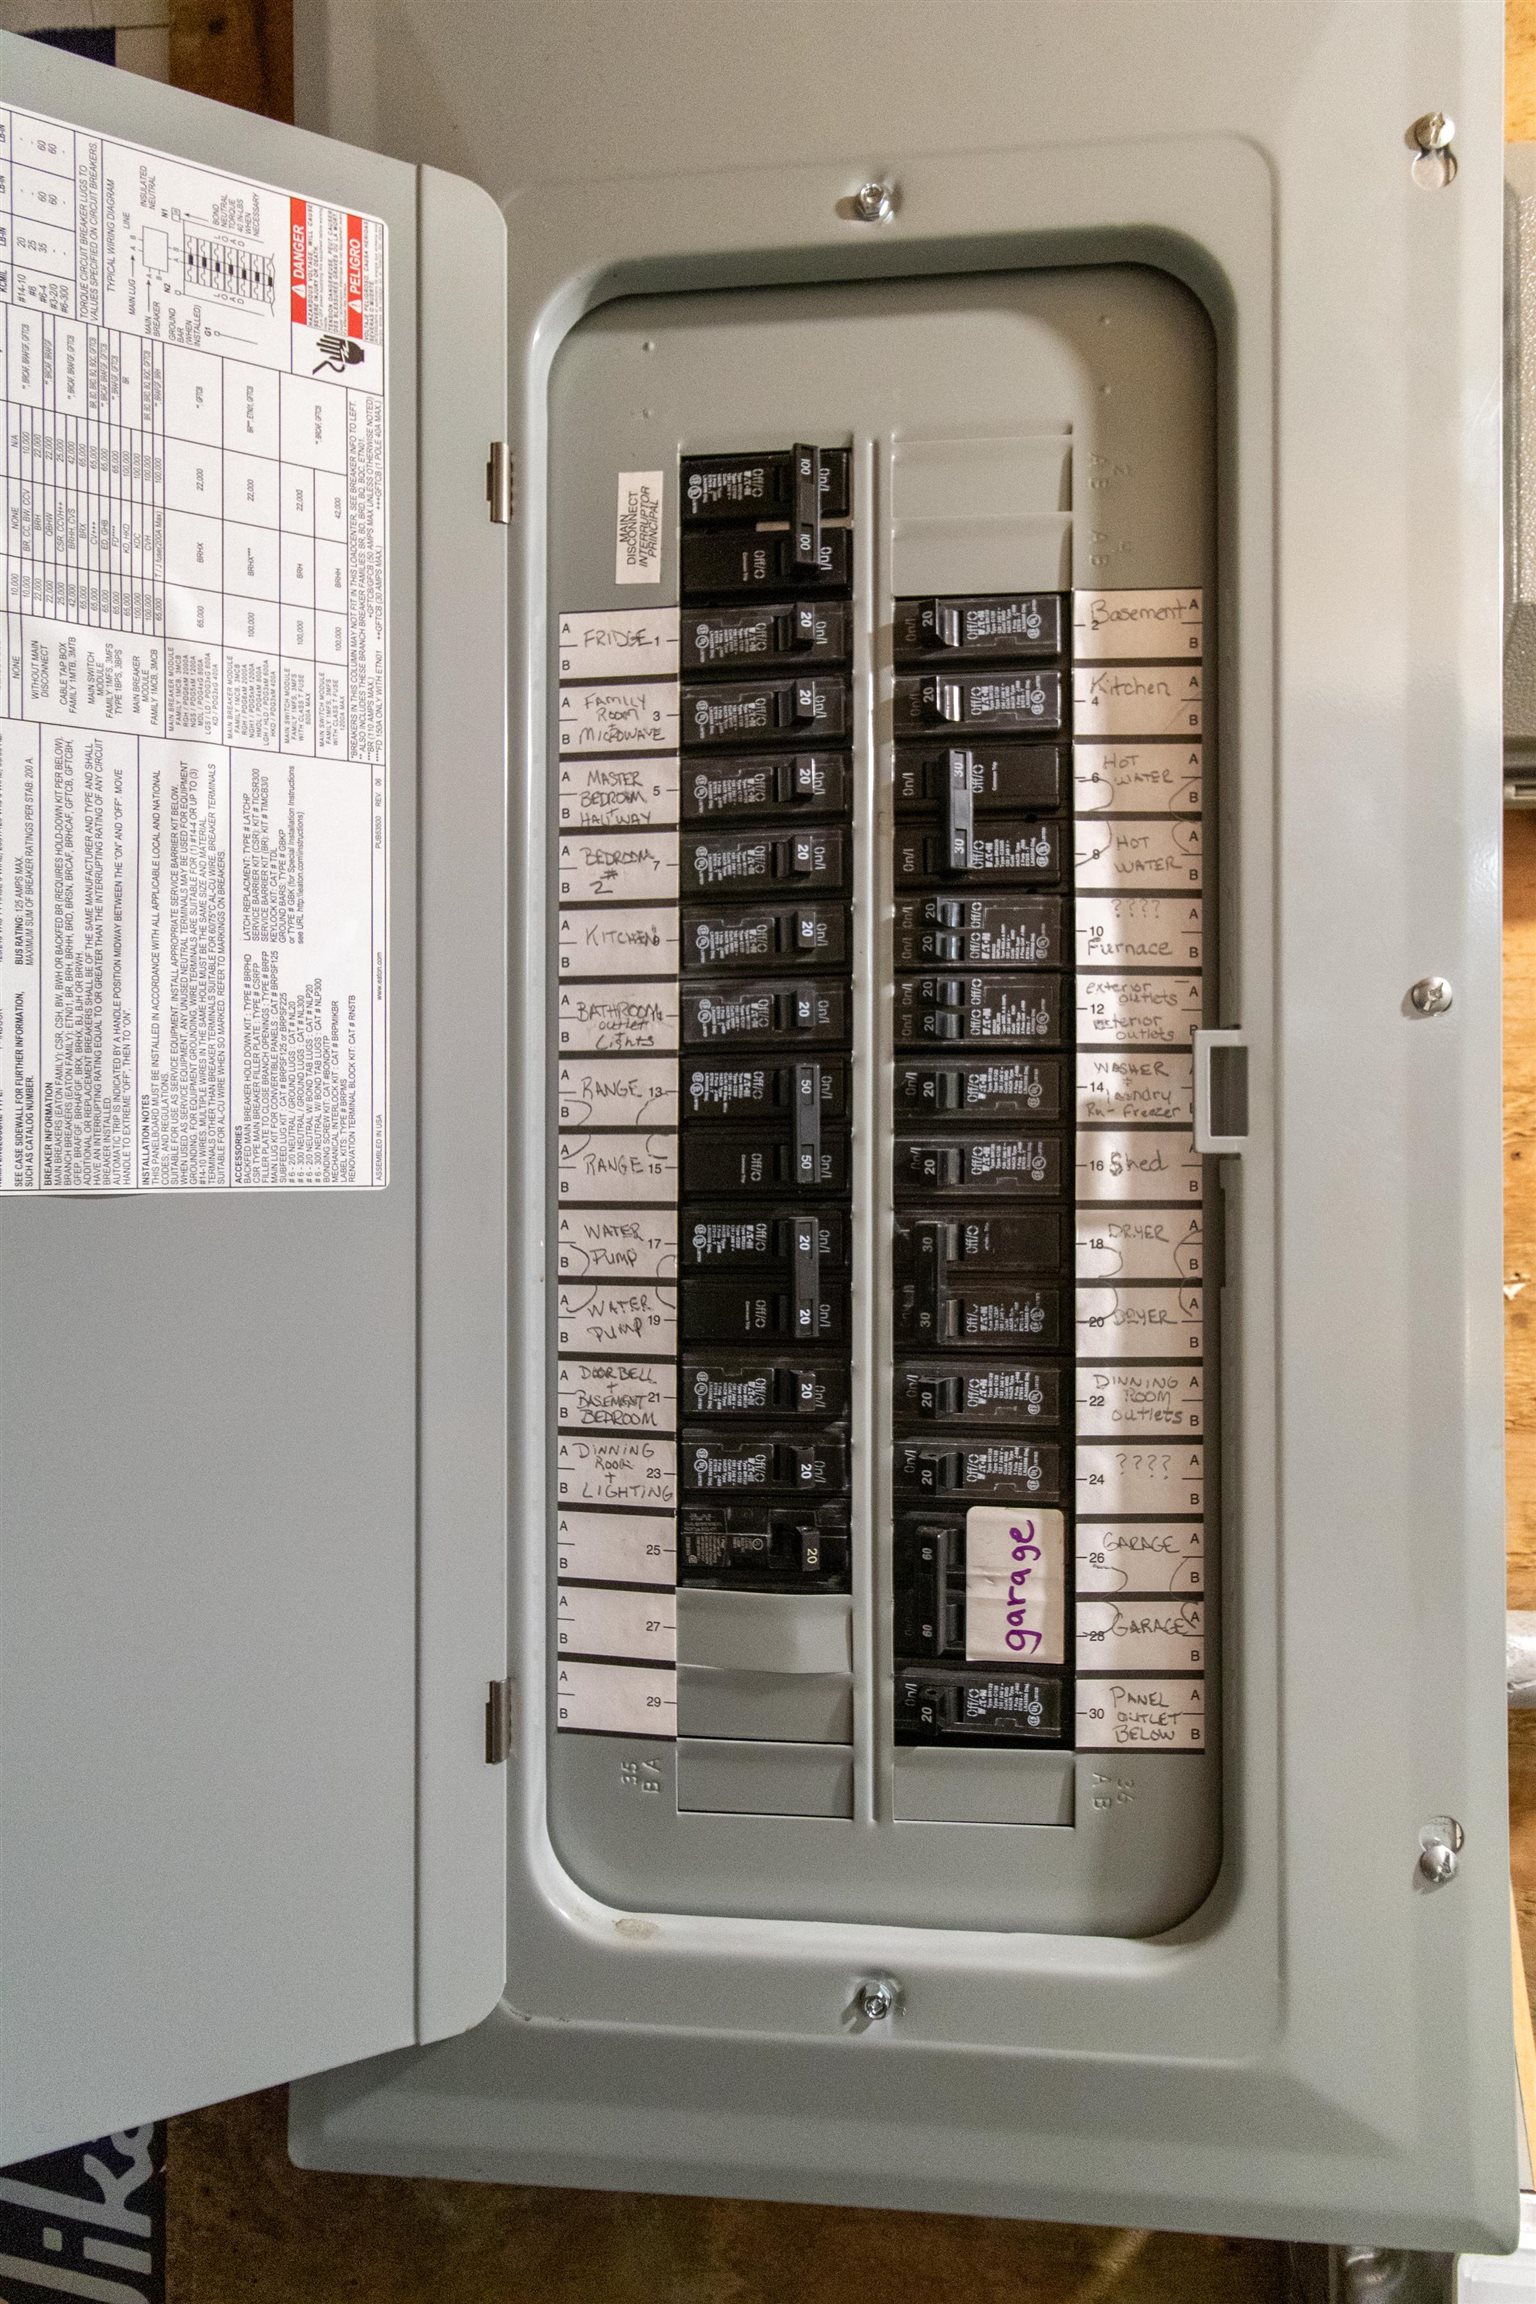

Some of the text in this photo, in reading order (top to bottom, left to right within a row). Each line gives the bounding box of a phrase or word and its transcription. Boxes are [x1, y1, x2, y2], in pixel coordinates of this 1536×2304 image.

[123, 212, 131, 229] LINE
[107, 178, 116, 292] TYPICAL WIRING DIAGRAM
[292, 225, 304, 279] DANGER
[349, 238, 361, 295] PELIGRO
[801, 459, 810, 475] 100
[620, 515, 629, 542] MAIN
[627, 491, 636, 564] DISCONNECT
[638, 486, 649, 567] INTERRUPTOR
[649, 499, 658, 558] PRINCIPAL
[801, 534, 810, 550] 100
[801, 611, 812, 627] 20
[922, 610, 933, 627] 20
[1090, 601, 1184, 622] Basement
[1091, 621, 1098, 630] 2
[584, 630, 652, 648] FRIDGE
[1089, 672, 1170, 697] Kitchen
[585, 693, 646, 709] FAMILY
[801, 690, 810, 705] 20
[923, 687, 934, 702] 20
[1091, 697, 1098, 705] 4
[596, 708, 639, 723] ROOM
[653, 711, 660, 721] 3
[954, 761, 964, 777] 30
[1103, 755, 1139, 769] HOT
[587, 771, 643, 786] MASTER
[800, 768, 810, 784] 20
[1114, 770, 1173, 785] WATER
[581, 791, 647, 806] BEDROOM
[653, 786, 660, 796] 5
[954, 839, 964, 854] 30
[1116, 836, 1149, 850] HOT
[580, 848, 655, 865] BEDROOM
[799, 845, 808, 860] 20
[1093, 850, 1100, 859] 8
[653, 861, 659, 870] 7
[1115, 856, 1182, 873] WATER
[590, 881, 613, 894] 2
[925, 903, 936, 919] 20
[803, 921, 812, 937] 20
[1089, 926, 1103, 936] 10
[15, 915, 23, 965] BUS RATING:
[923, 936, 933, 952] 20
[1088, 937, 1172, 956] Furnace
[923, 981, 933, 997] 20
[1119, 991, 1178, 1006] outlets
[799, 1002, 809, 1017] 20
[1090, 1004, 1104, 1015] 12
[924, 1016, 934, 1032] 20
[1115, 1026, 1174, 1041] outlets
[1094, 1061, 1169, 1077] WASHER
[15, 992, 25, 1187] SEE CASE SIDEWALL FOR FURTHER INFORMATION,
[26, 1076, 34, 1109] NUMBER.
[582, 1076, 642, 1098] RANGE
[649, 1088, 661, 1096] 13
[801, 1079, 812, 1094] 50
[924, 1081, 934, 1097] 20
[1090, 1082, 1103, 1092] 14
[45, 1082, 53, 1142] INFORMATION
[26, 1112, 34, 1151] CATALOG
[142, 1095, 150, 1185] INSTALLATION NOTES
[26, 1153, 33, 1166] AS
[234, 1126, 242, 1183] ACCESSORIES
[801, 1155, 812, 1169] 50
[585, 1156, 643, 1175] RANGE
[648, 1164, 661, 1174] 15
[925, 1159, 935, 1175] 20
[1089, 1160, 1103, 1171] 16
[1110, 1152, 1169, 1176] Shed
[585, 1224, 643, 1242] WATER
[1108, 1224, 1169, 1242] DRYER
[648, 1239, 660, 1249] 17
[800, 1235, 809, 1250] 20
[922, 1236, 933, 1252] 30
[1090, 1238, 1103, 1248] 18
[593, 1250, 637, 1265] PUMP
[587, 1295, 653, 1318] WATER
[648, 1315, 660, 1325] 19
[800, 1309, 810, 1324] 20
[921, 1312, 930, 1328] 30
[1089, 1316, 1104, 1327] 20
[588, 1322, 643, 1341] PUMP
[576, 1390, 647, 1408] BASEMENT
[648, 1392, 660, 1402] 21
[802, 1384, 812, 1399] 20
[1124, 1388, 1171, 1402] ROOM
[922, 1392, 932, 1408] 20
[1090, 1396, 1104, 1406] 22
[581, 1410, 657, 1426] BEDROOM
[1112, 1406, 1183, 1423] outlets
[647, 1468, 660, 1478] 23
[802, 1464, 812, 1479] 20
[922, 1469, 932, 1485] 20
[1090, 1475, 1104, 1485] 24
[583, 1483, 672, 1500] LIGHTING
[1103, 1532, 1180, 1553] GARAGE
[647, 1546, 660, 1556] 25
[807, 1549, 817, 1564] 20
[1089, 1553, 1104, 1563] 26
[1005, 1518, 1042, 1654] garage
[646, 1622, 660, 1631] 27
[1112, 1614, 1185, 1635] GARAGE
[1089, 1631, 1105, 1641] 28
[646, 1697, 661, 1707] 29
[1110, 1685, 1170, 1708] PANEL
[922, 1707, 932, 1723] 20
[1089, 1709, 1104, 1719] 30
[1118, 1712, 1182, 1725] OUTLET
[1114, 1725, 1175, 1742] BELOW
